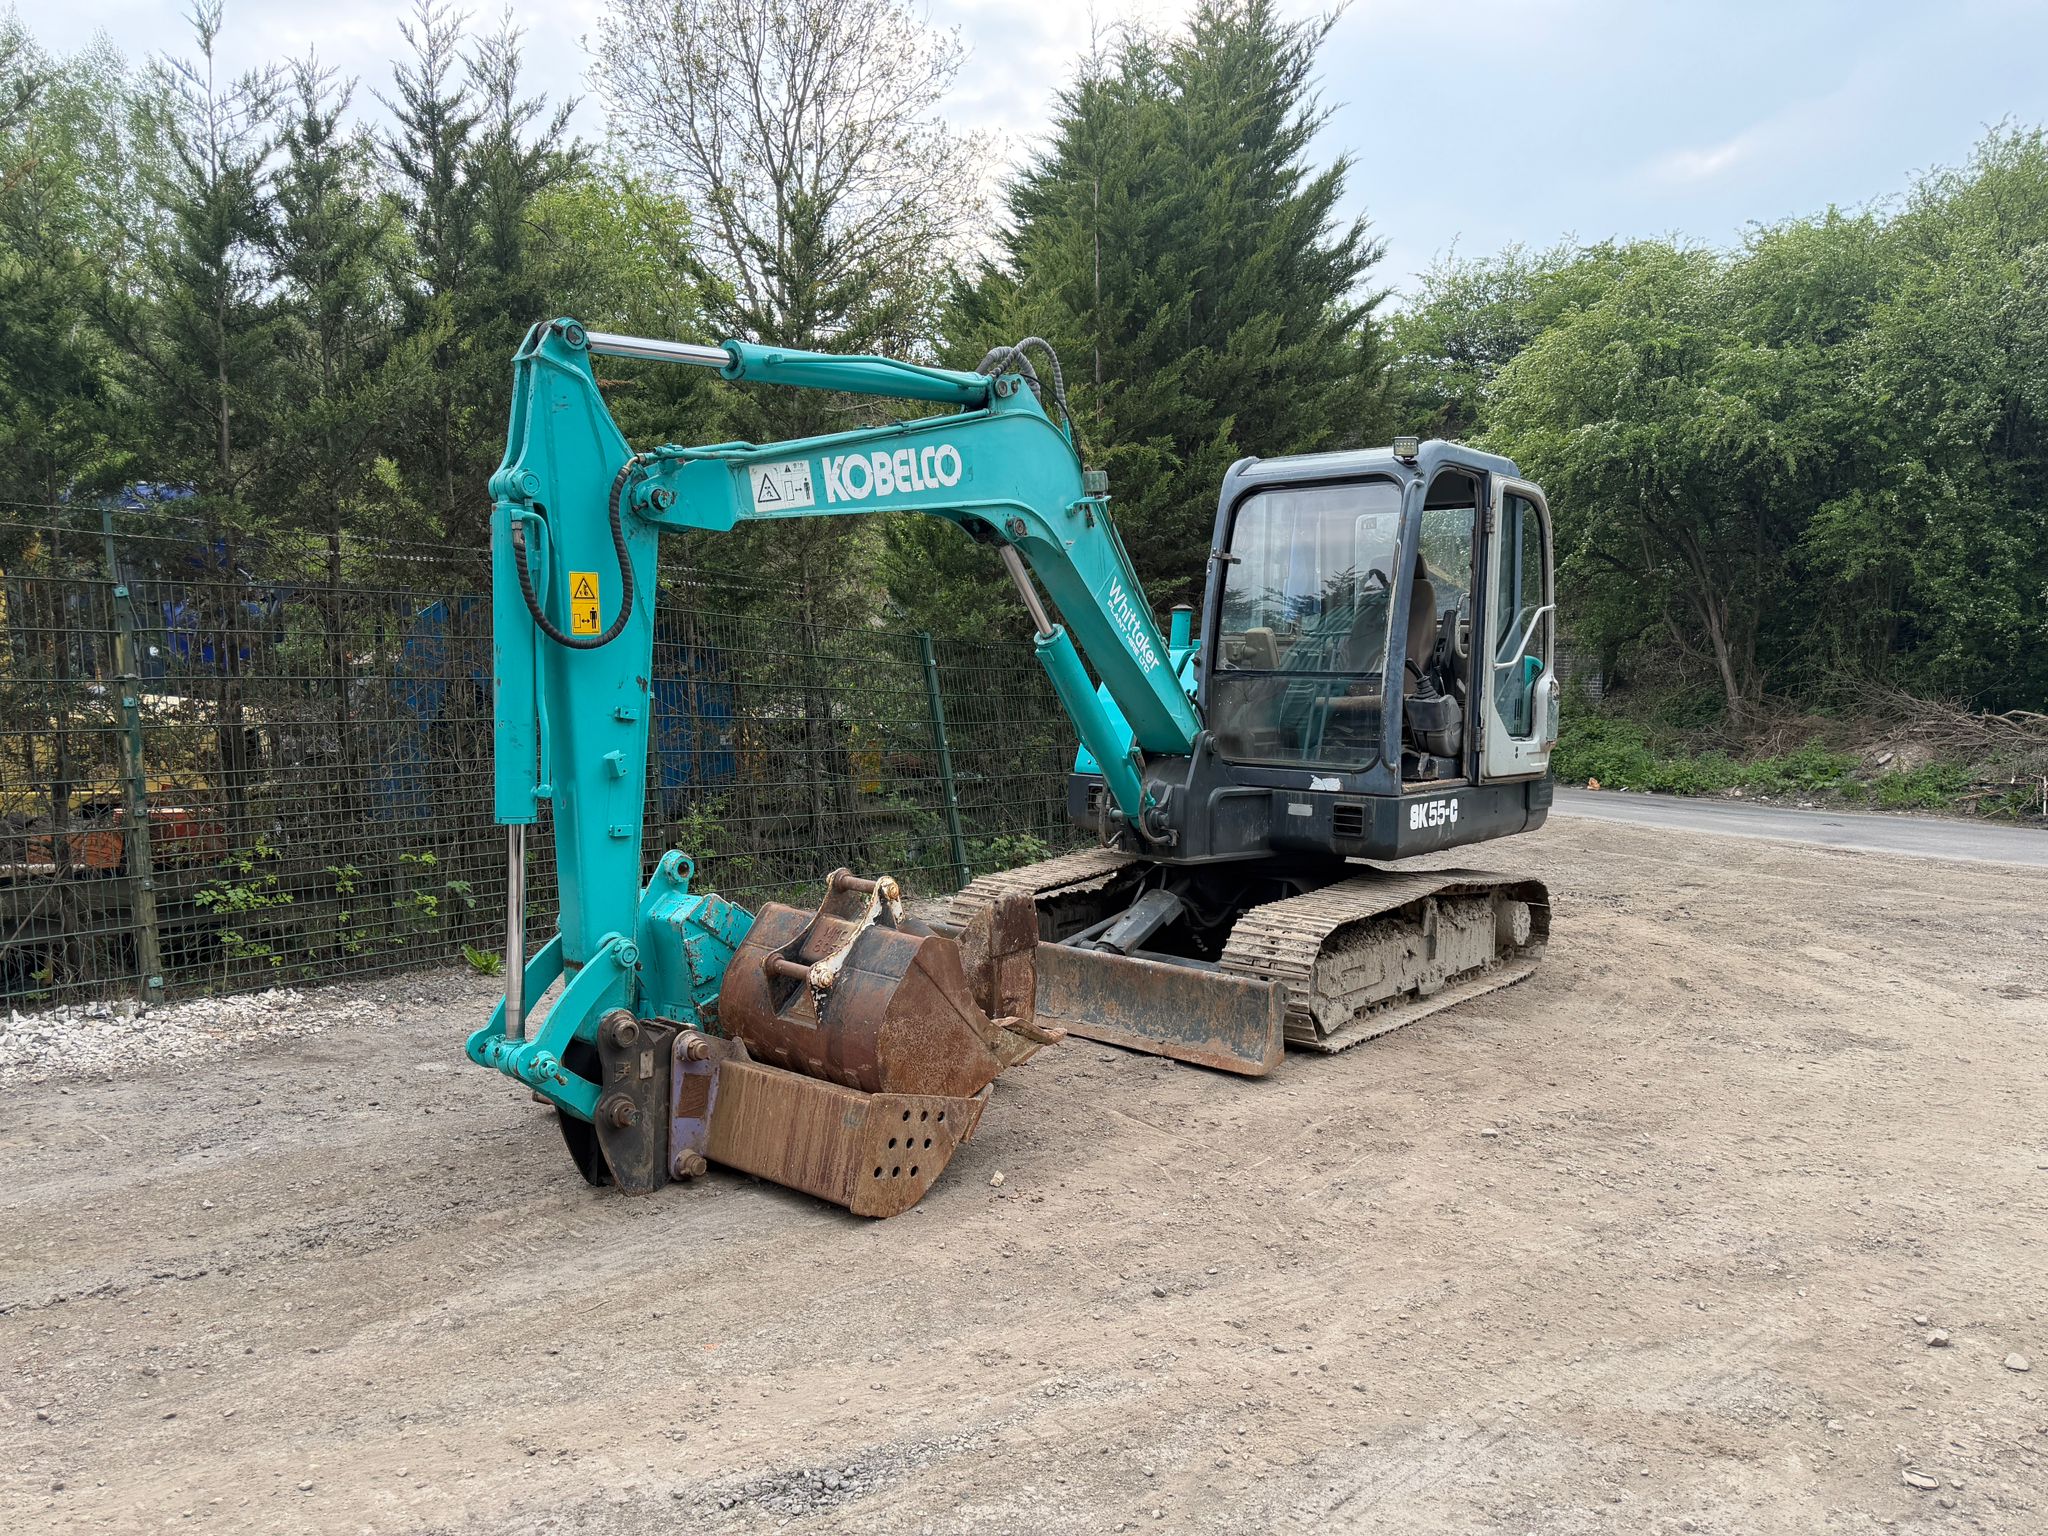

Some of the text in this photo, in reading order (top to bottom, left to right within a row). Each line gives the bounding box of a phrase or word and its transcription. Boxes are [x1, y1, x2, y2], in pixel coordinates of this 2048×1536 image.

[822, 444, 962, 503] KOBELCO
[1107, 600, 1150, 673] PLANT HIRE LTD
[1109, 576, 1160, 670] Whittaker
